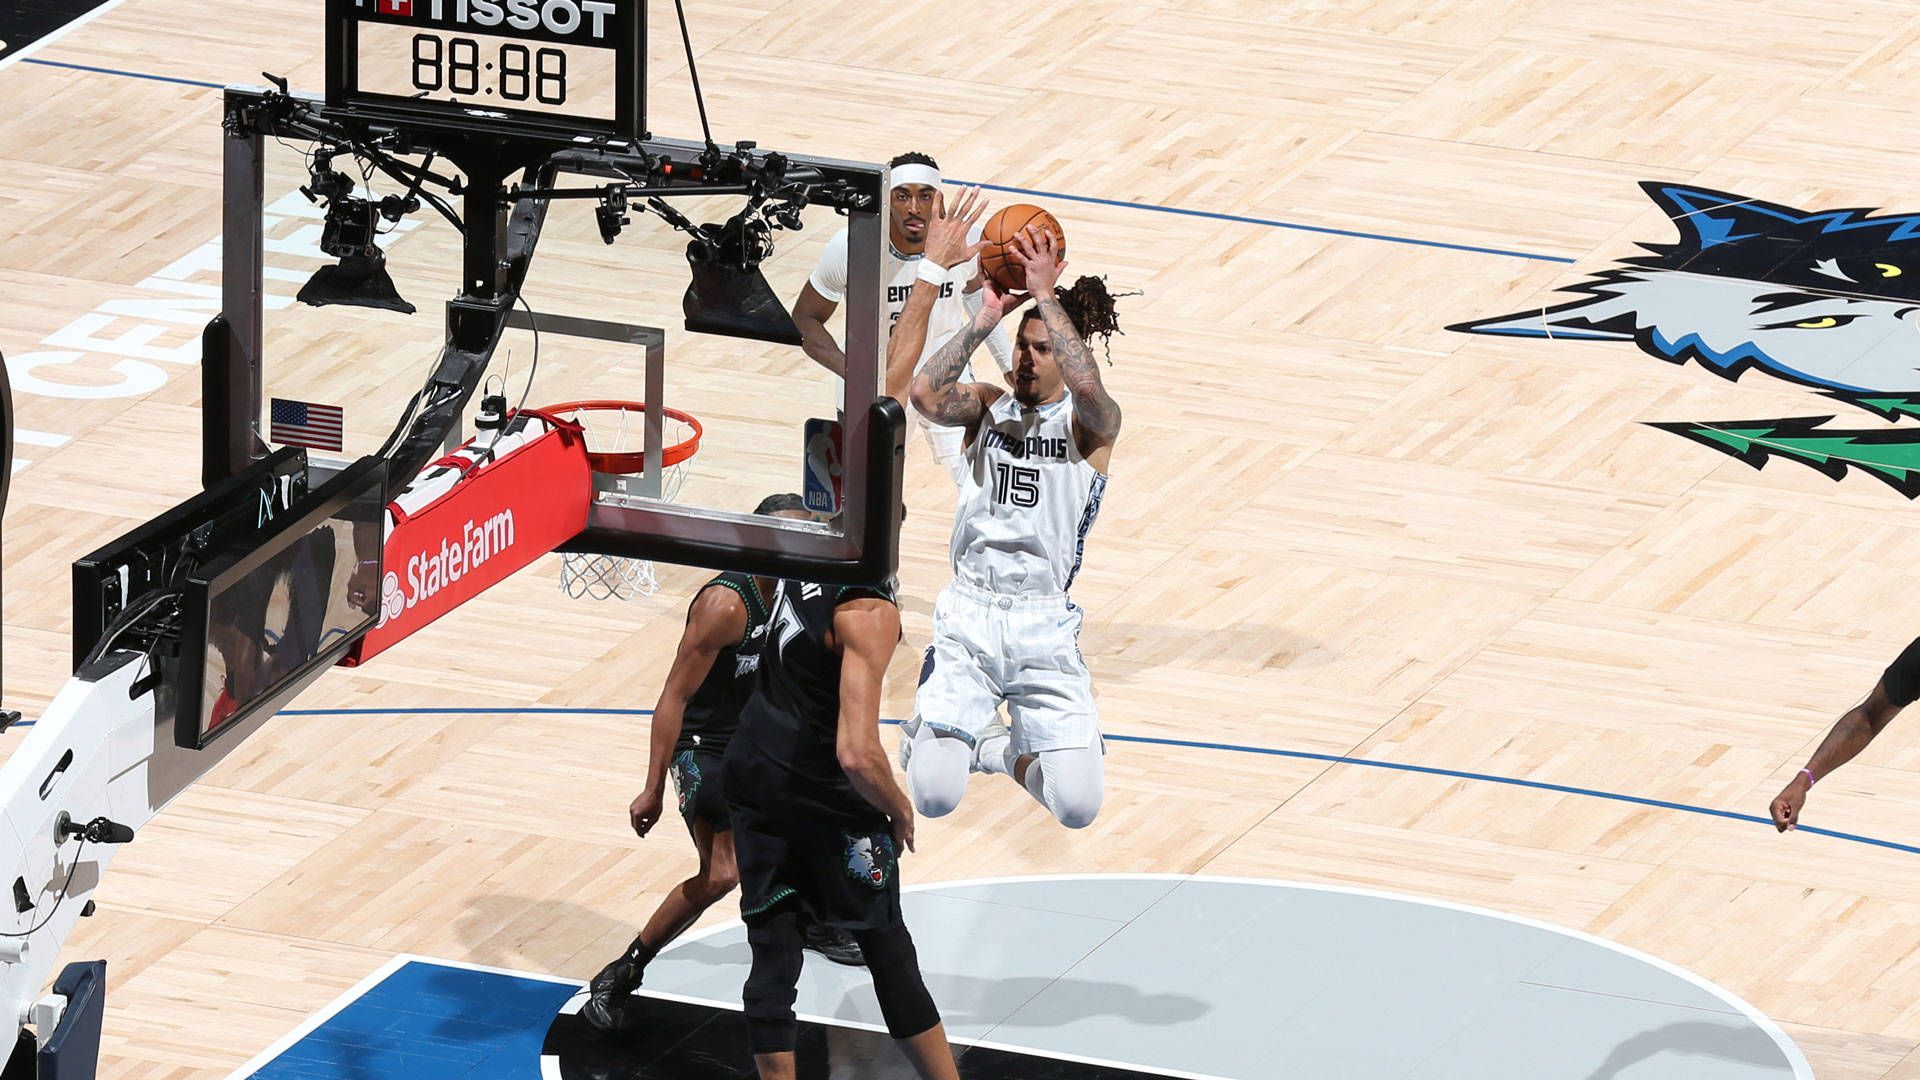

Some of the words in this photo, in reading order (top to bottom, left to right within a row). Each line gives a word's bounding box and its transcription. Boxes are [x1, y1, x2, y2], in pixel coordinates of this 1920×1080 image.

[412, 33, 566, 105] 88:88
[808, 490, 828, 508] NBA
[997, 462, 1040, 508] 15
